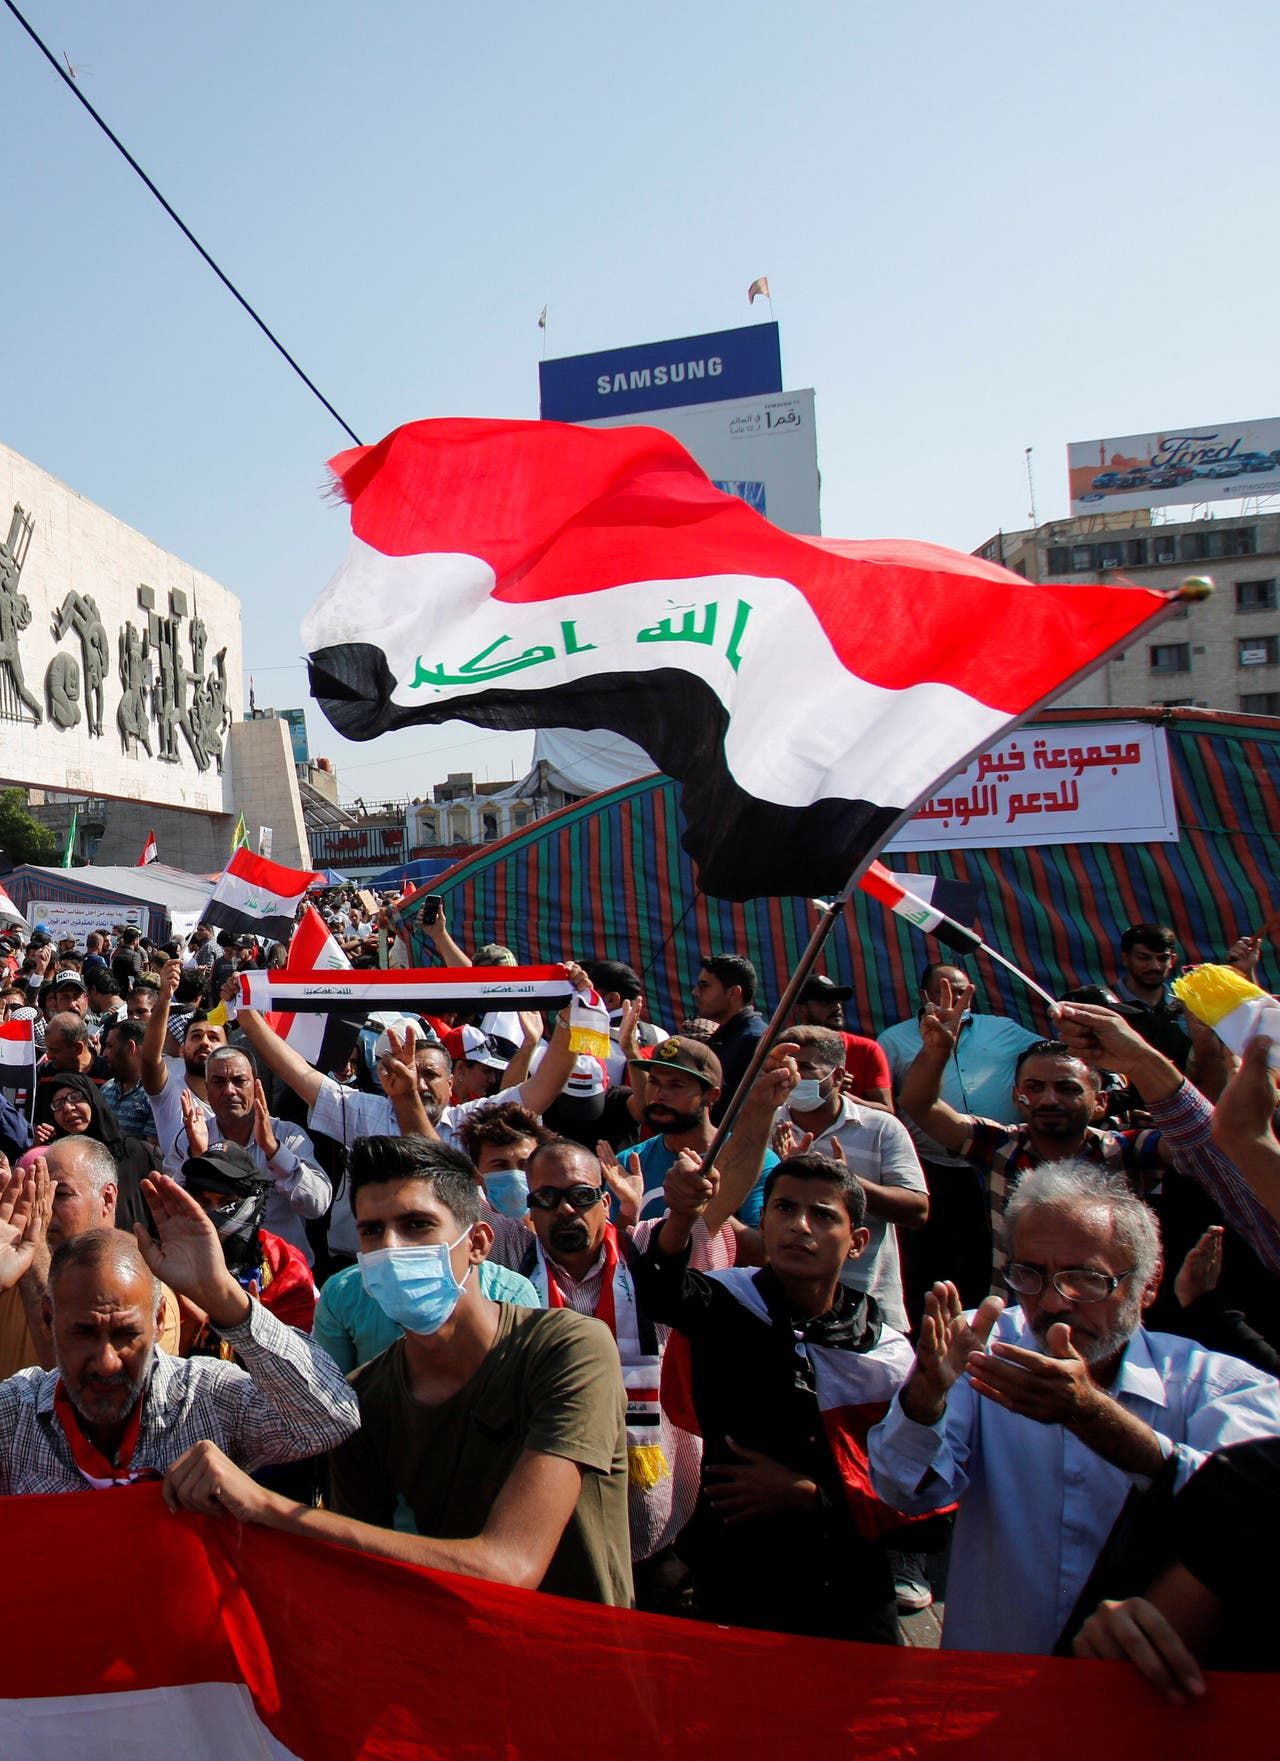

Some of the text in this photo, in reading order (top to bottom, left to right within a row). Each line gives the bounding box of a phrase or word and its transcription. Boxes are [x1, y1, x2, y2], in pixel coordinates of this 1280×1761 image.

[597, 357, 723, 395] SAMSUNG
[1151, 434, 1243, 467] Ford
[636, 598, 754, 675] الله
[976, 740, 1141, 783] مجموعة خيم
[1006, 779, 1079, 823] للدعم
